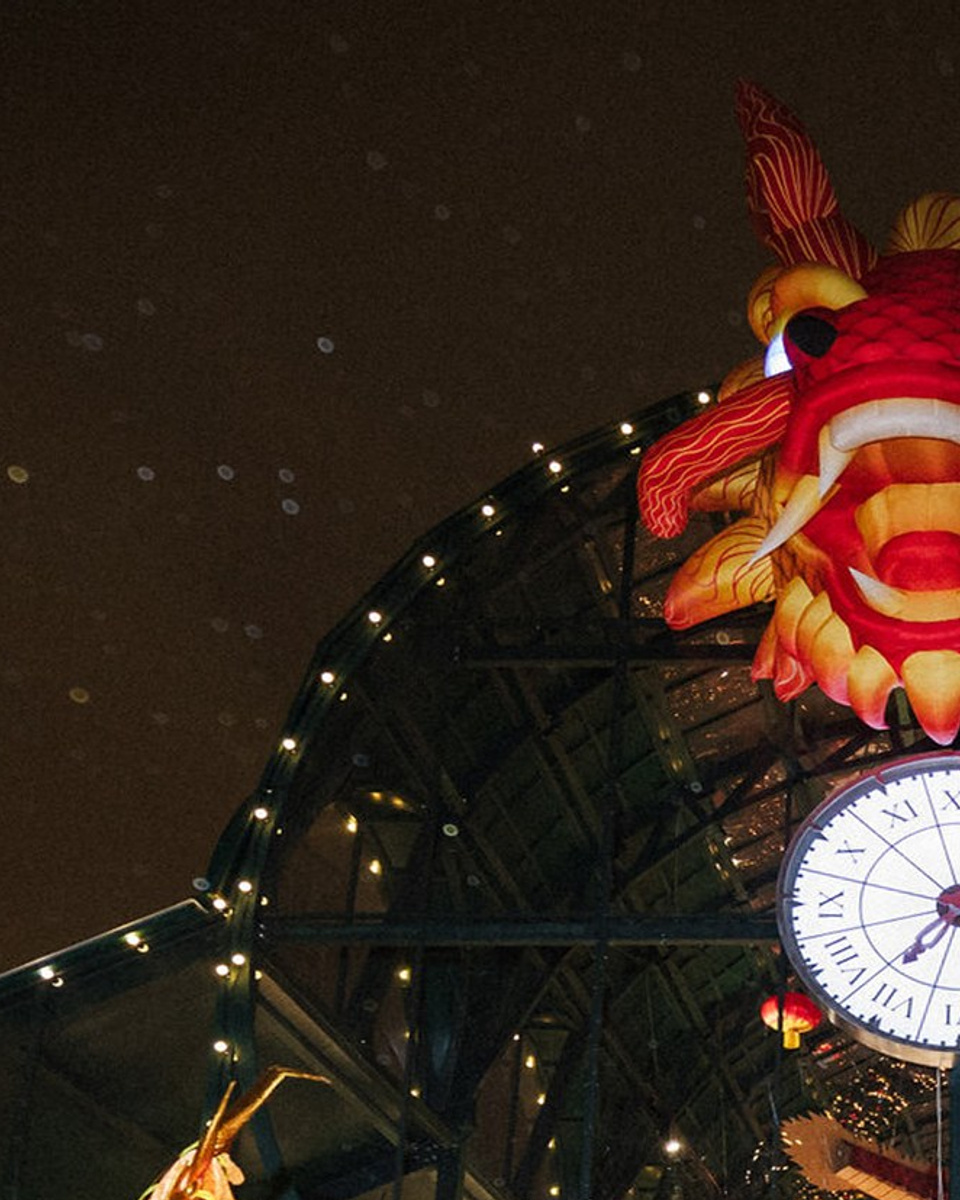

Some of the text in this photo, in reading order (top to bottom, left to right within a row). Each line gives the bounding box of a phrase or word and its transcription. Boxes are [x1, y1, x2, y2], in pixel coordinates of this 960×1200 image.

[881, 799, 919, 829] XI
[835, 839, 866, 864] X
[818, 890, 844, 918] IX
[824, 936, 867, 986] VIII
[871, 982, 915, 1018] VII
